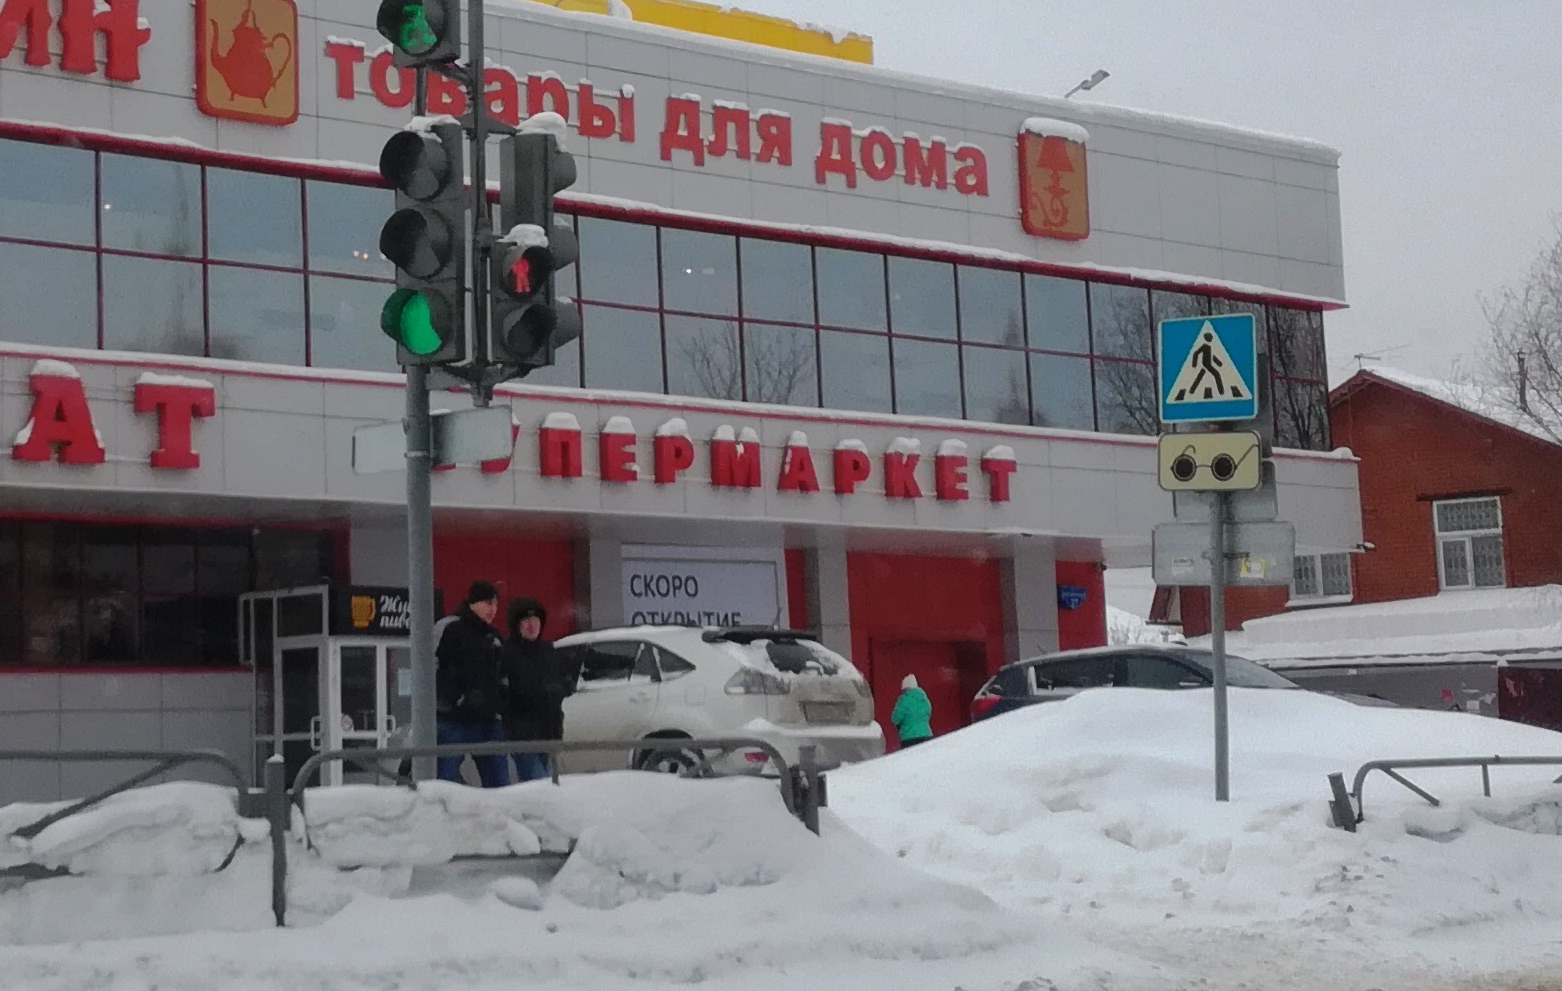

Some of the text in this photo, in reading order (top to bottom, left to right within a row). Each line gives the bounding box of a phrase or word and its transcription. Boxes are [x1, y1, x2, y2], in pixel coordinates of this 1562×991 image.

[325, 41, 989, 197] товары для дома
[432, 420, 1018, 502] ПЕРМАРКЕТ
[630, 573, 698, 598] СКОРО
